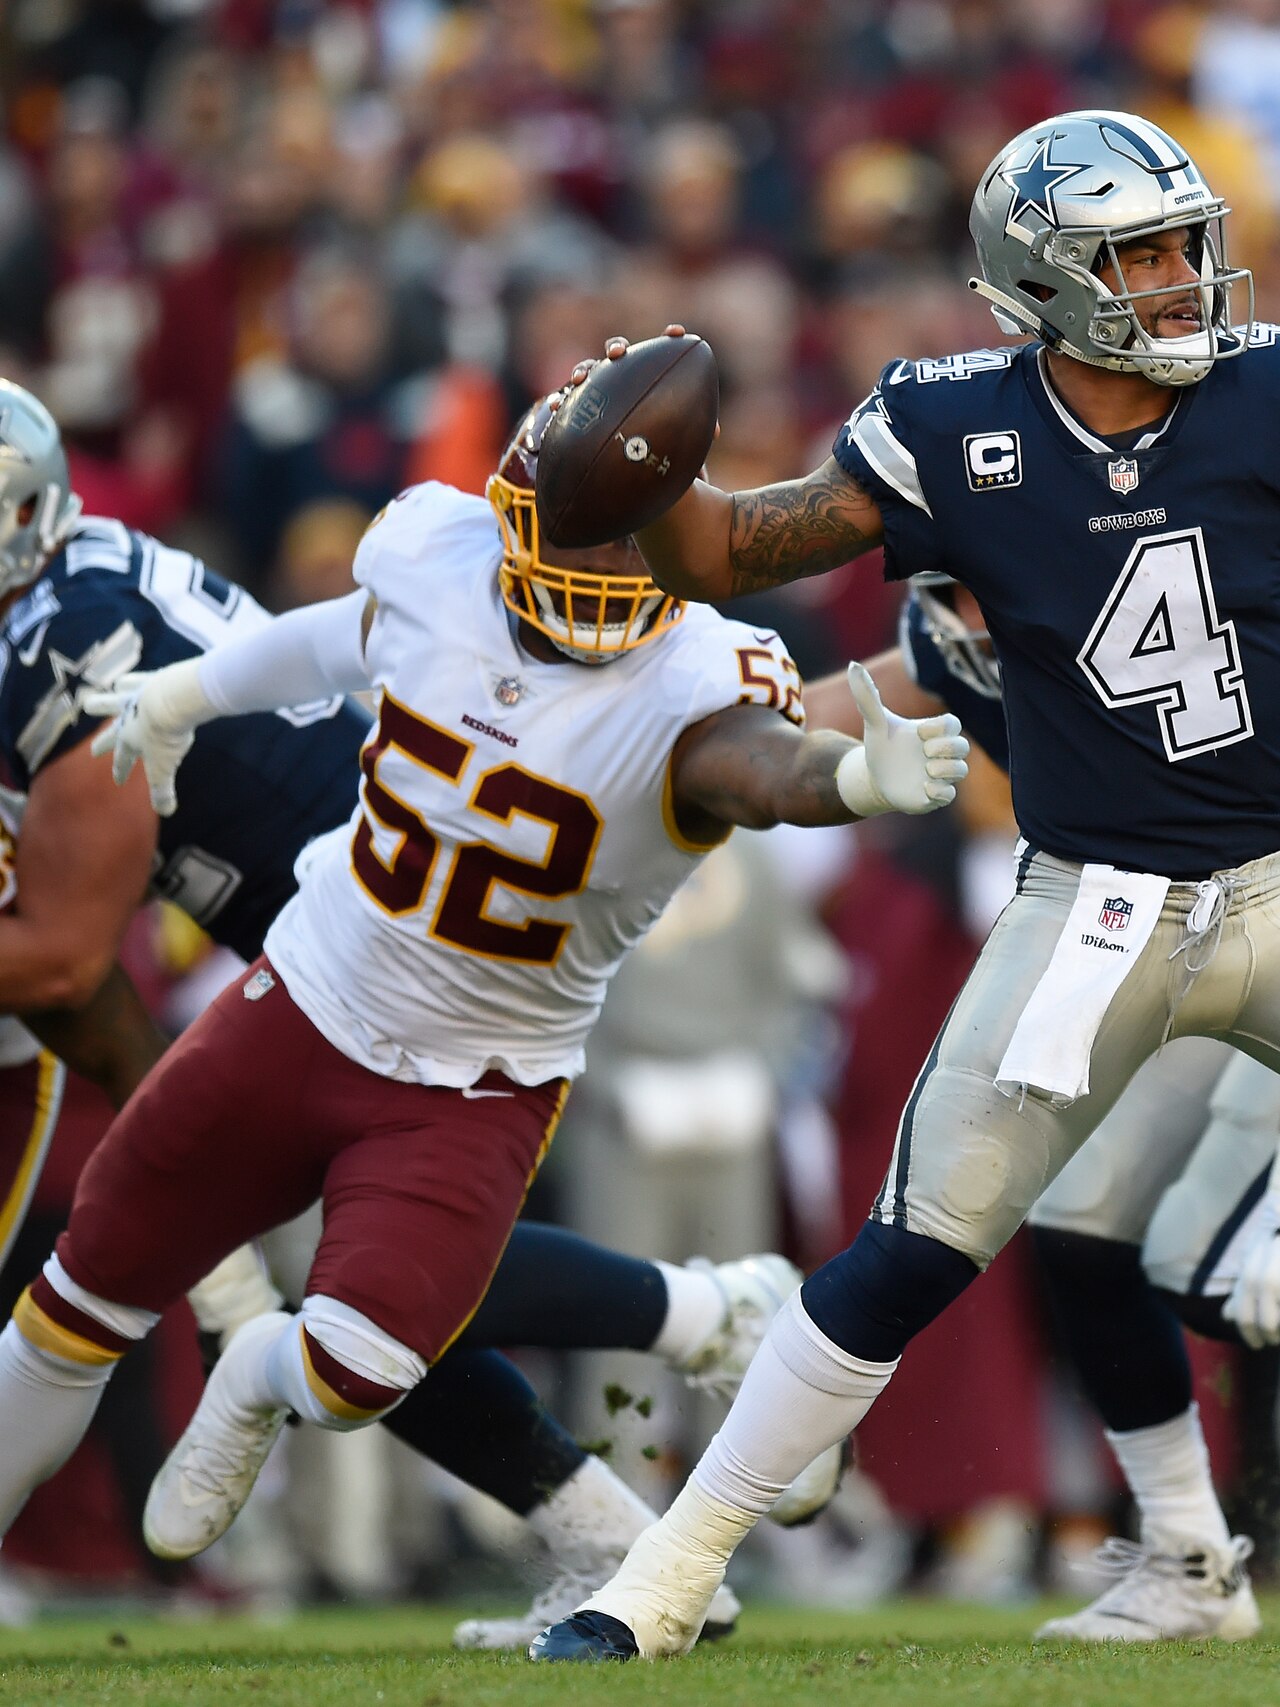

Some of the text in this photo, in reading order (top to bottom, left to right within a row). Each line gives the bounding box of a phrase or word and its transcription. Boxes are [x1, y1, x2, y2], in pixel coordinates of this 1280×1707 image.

[916, 352, 1012, 384] 4
[968, 435, 1016, 476] C
[1113, 472, 1135, 488] NFL
[1088, 507, 1167, 533] COWBOYS
[1075, 526, 1255, 763] 4
[461, 713, 519, 748] REDSKINS
[349, 683, 606, 968] 52
[1100, 909, 1126, 929] NFL
[1080, 933, 1126, 953] Wilson
